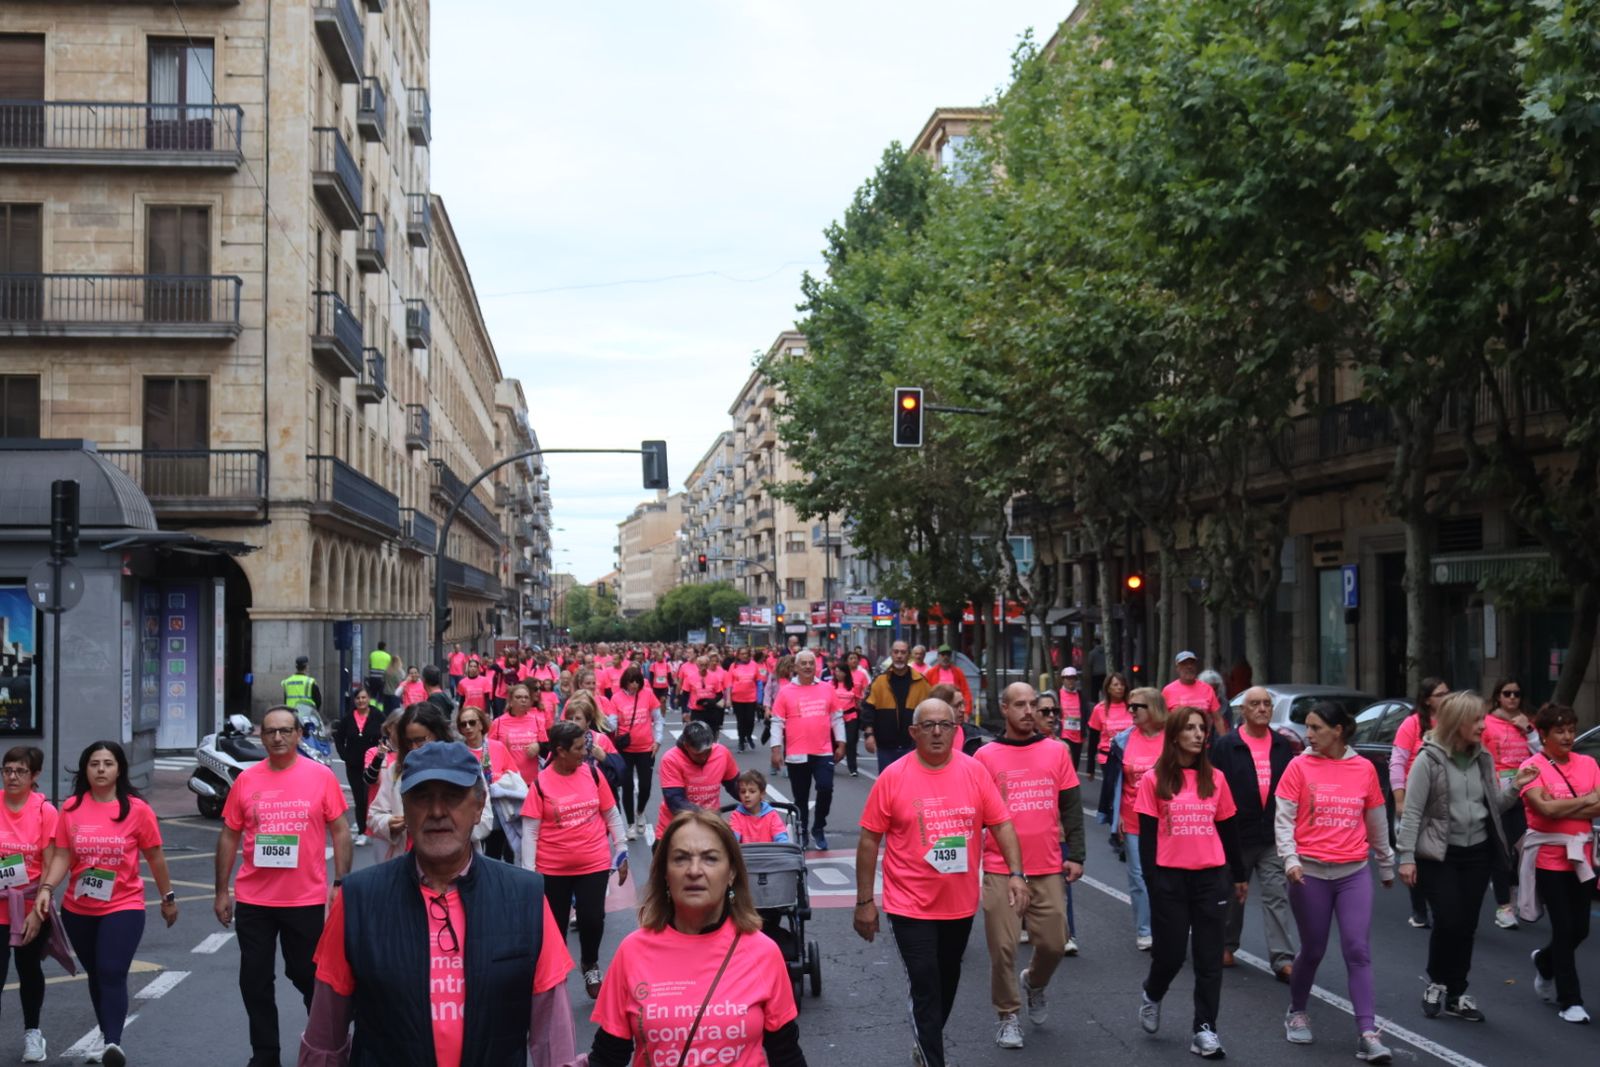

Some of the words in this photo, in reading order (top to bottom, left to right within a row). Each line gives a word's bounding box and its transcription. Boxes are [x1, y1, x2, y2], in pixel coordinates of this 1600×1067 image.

[1344, 569, 1354, 606] P
[1008, 788, 1044, 800] contra
[258, 801, 272, 810] En
[273, 799, 311, 809] marcha
[1170, 802, 1184, 811] En
[259, 810, 297, 821] contra
[297, 808, 309, 819] el
[924, 809, 938, 819] En
[938, 806, 977, 817] marcha
[259, 820, 310, 833] cáncer
[926, 818, 964, 831] contra
[1314, 815, 1359, 829] cánce
[1171, 822, 1214, 836] cánce
[90, 835, 126, 845] marcha
[262, 845, 291, 856] 10584
[934, 848, 957, 861] 7439
[647, 1003, 669, 1020] En
[726, 1019, 747, 1040] el
[653, 1043, 746, 1067] cáncer
